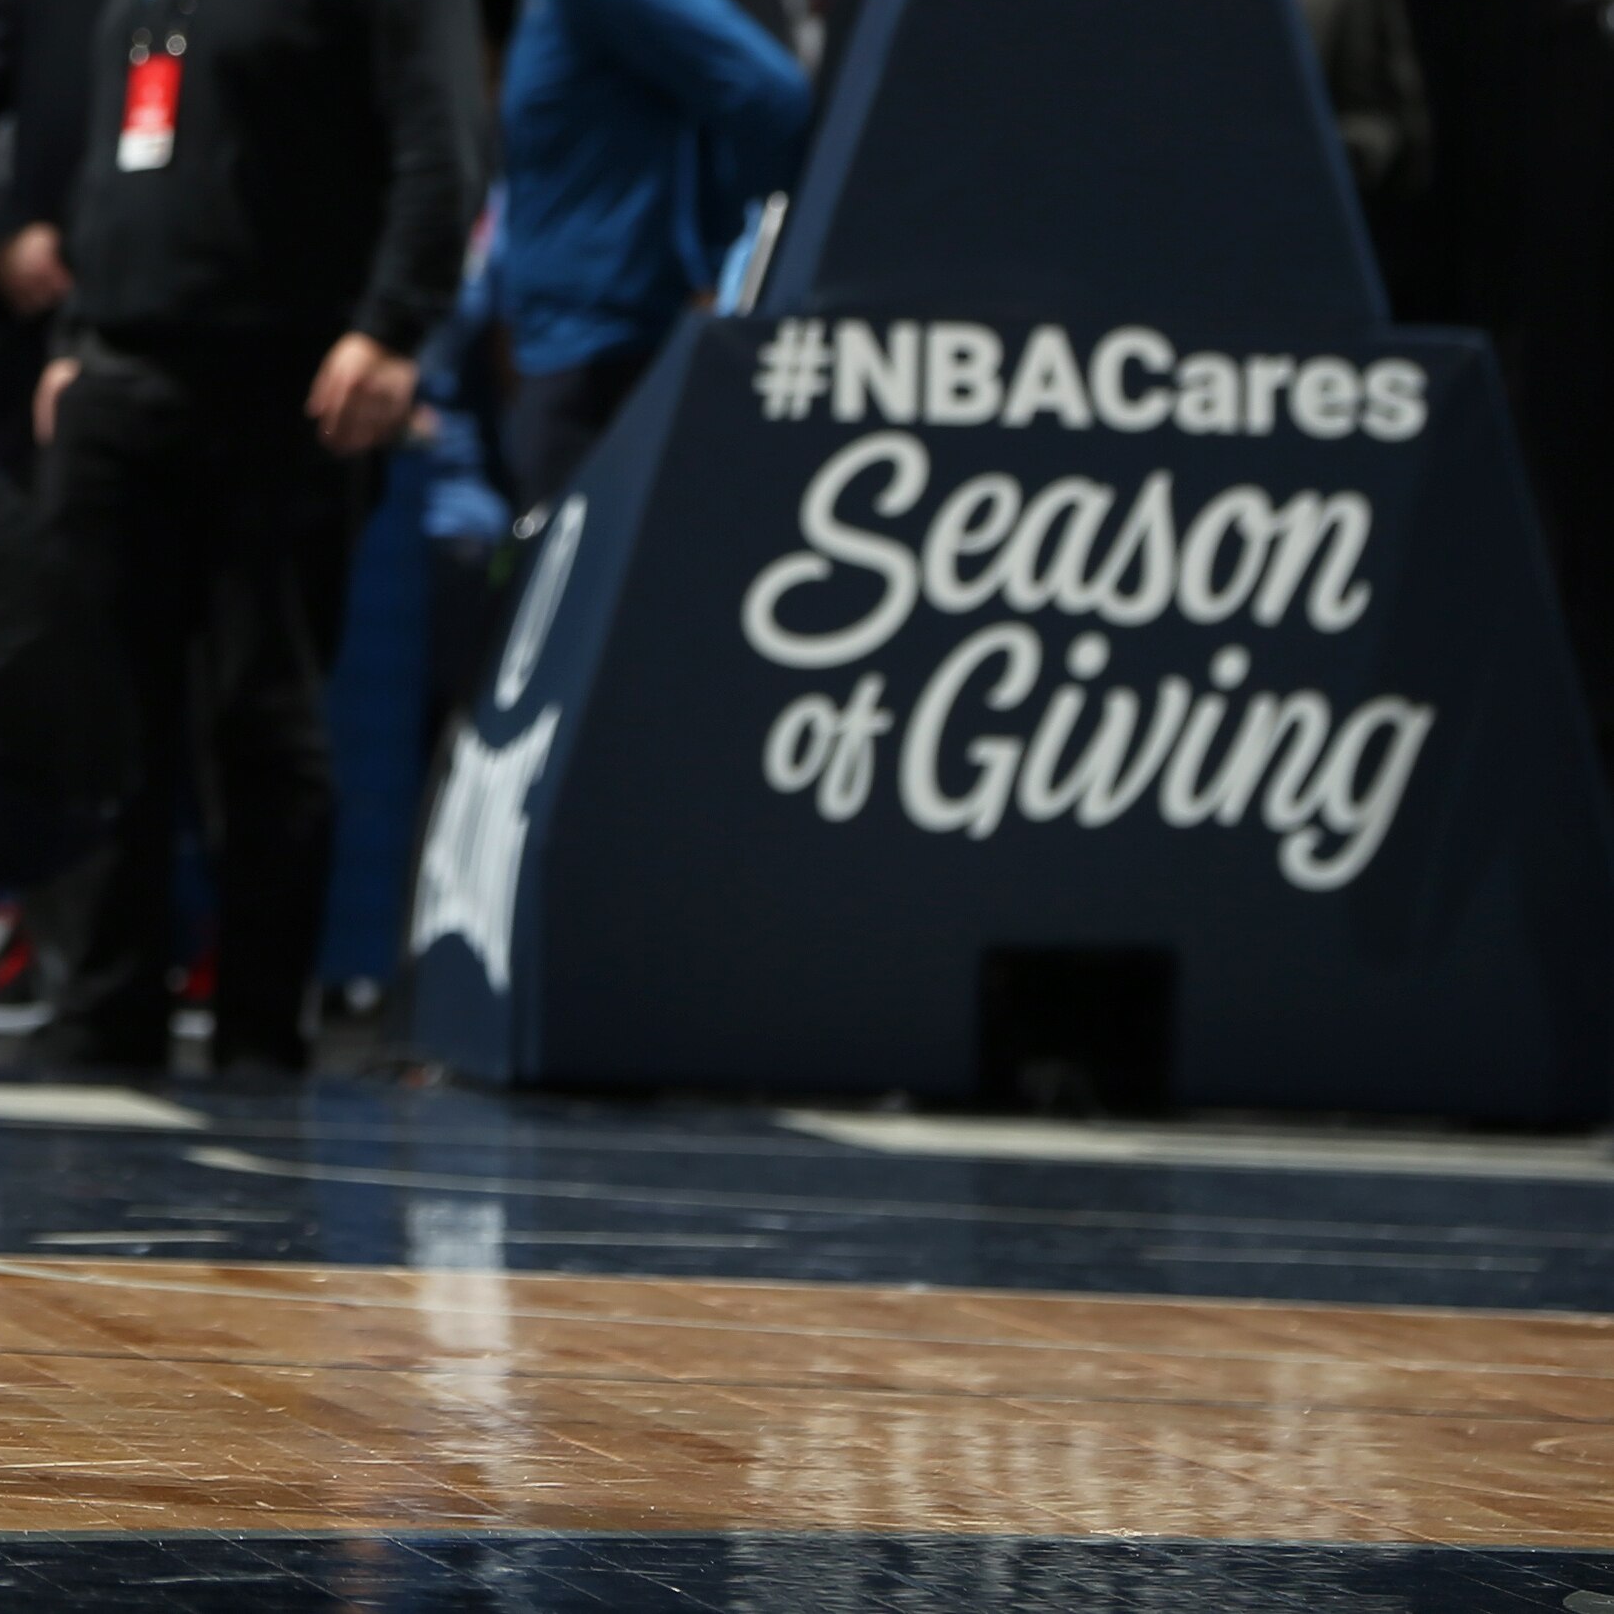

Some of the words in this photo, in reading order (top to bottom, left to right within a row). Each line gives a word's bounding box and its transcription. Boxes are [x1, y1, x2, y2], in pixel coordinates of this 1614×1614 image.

[754, 318, 1429, 442] #NBACares
[740, 429, 1374, 669] Season
[762, 673, 892, 823] of
[897, 621, 1436, 893] Giving
